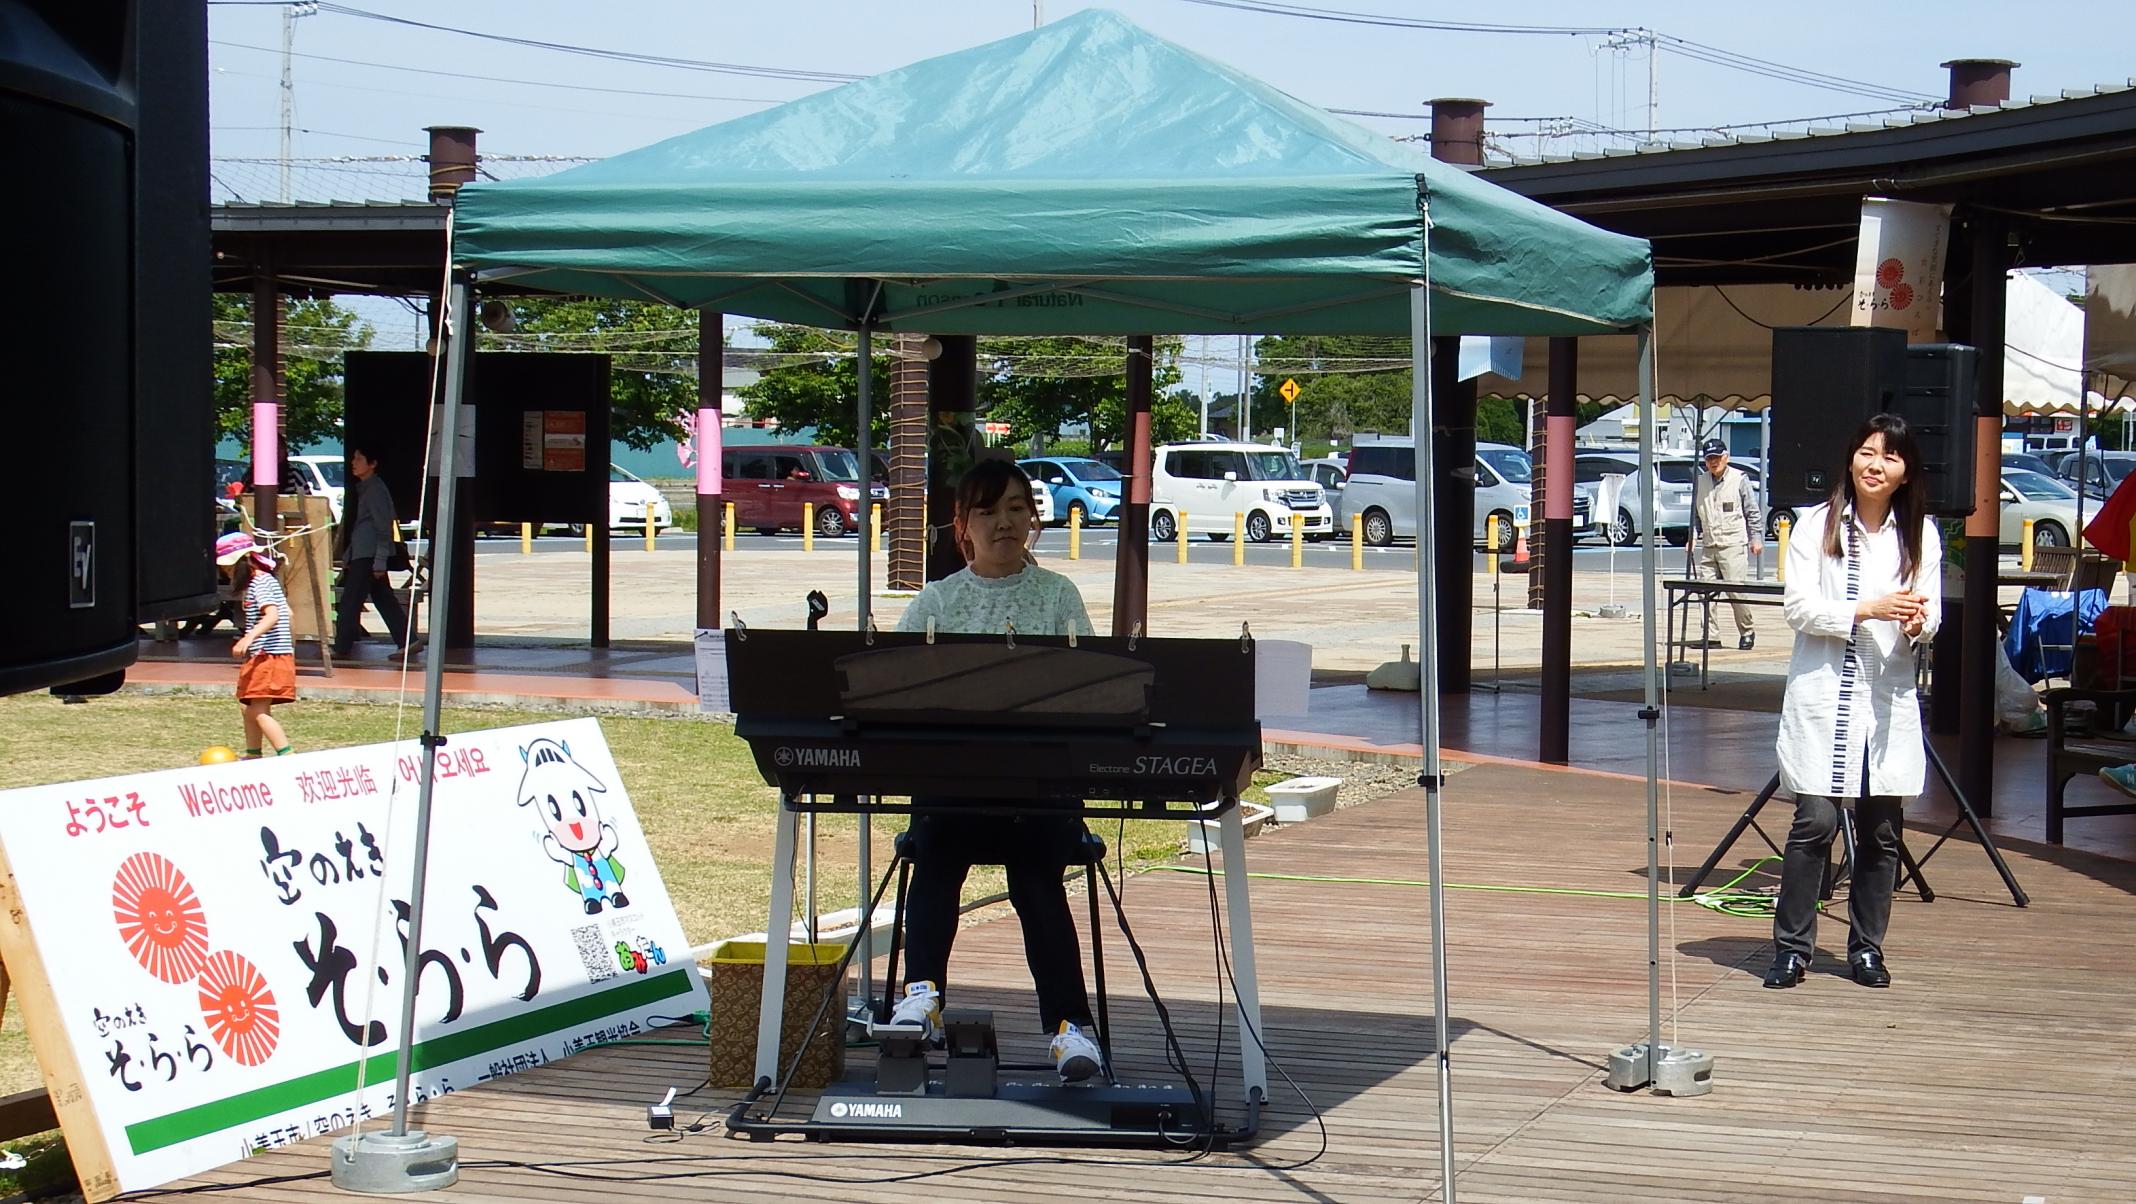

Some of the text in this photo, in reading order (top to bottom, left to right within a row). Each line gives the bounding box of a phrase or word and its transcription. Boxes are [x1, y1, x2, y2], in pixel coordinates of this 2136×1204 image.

[795, 748, 861, 767] YAMAHA
[1089, 756, 1217, 775] Electone STAGEA
[66, 791, 150, 837] ようこそ
[178, 781, 273, 817] Welcome
[295, 764, 378, 804] 欢迎光临
[260, 821, 384, 906] 空のえき
[93, 1002, 147, 1038] 空のえき
[105, 1024, 213, 1092] そ・ら・ら
[848, 1103, 902, 1118] YAMAHA
